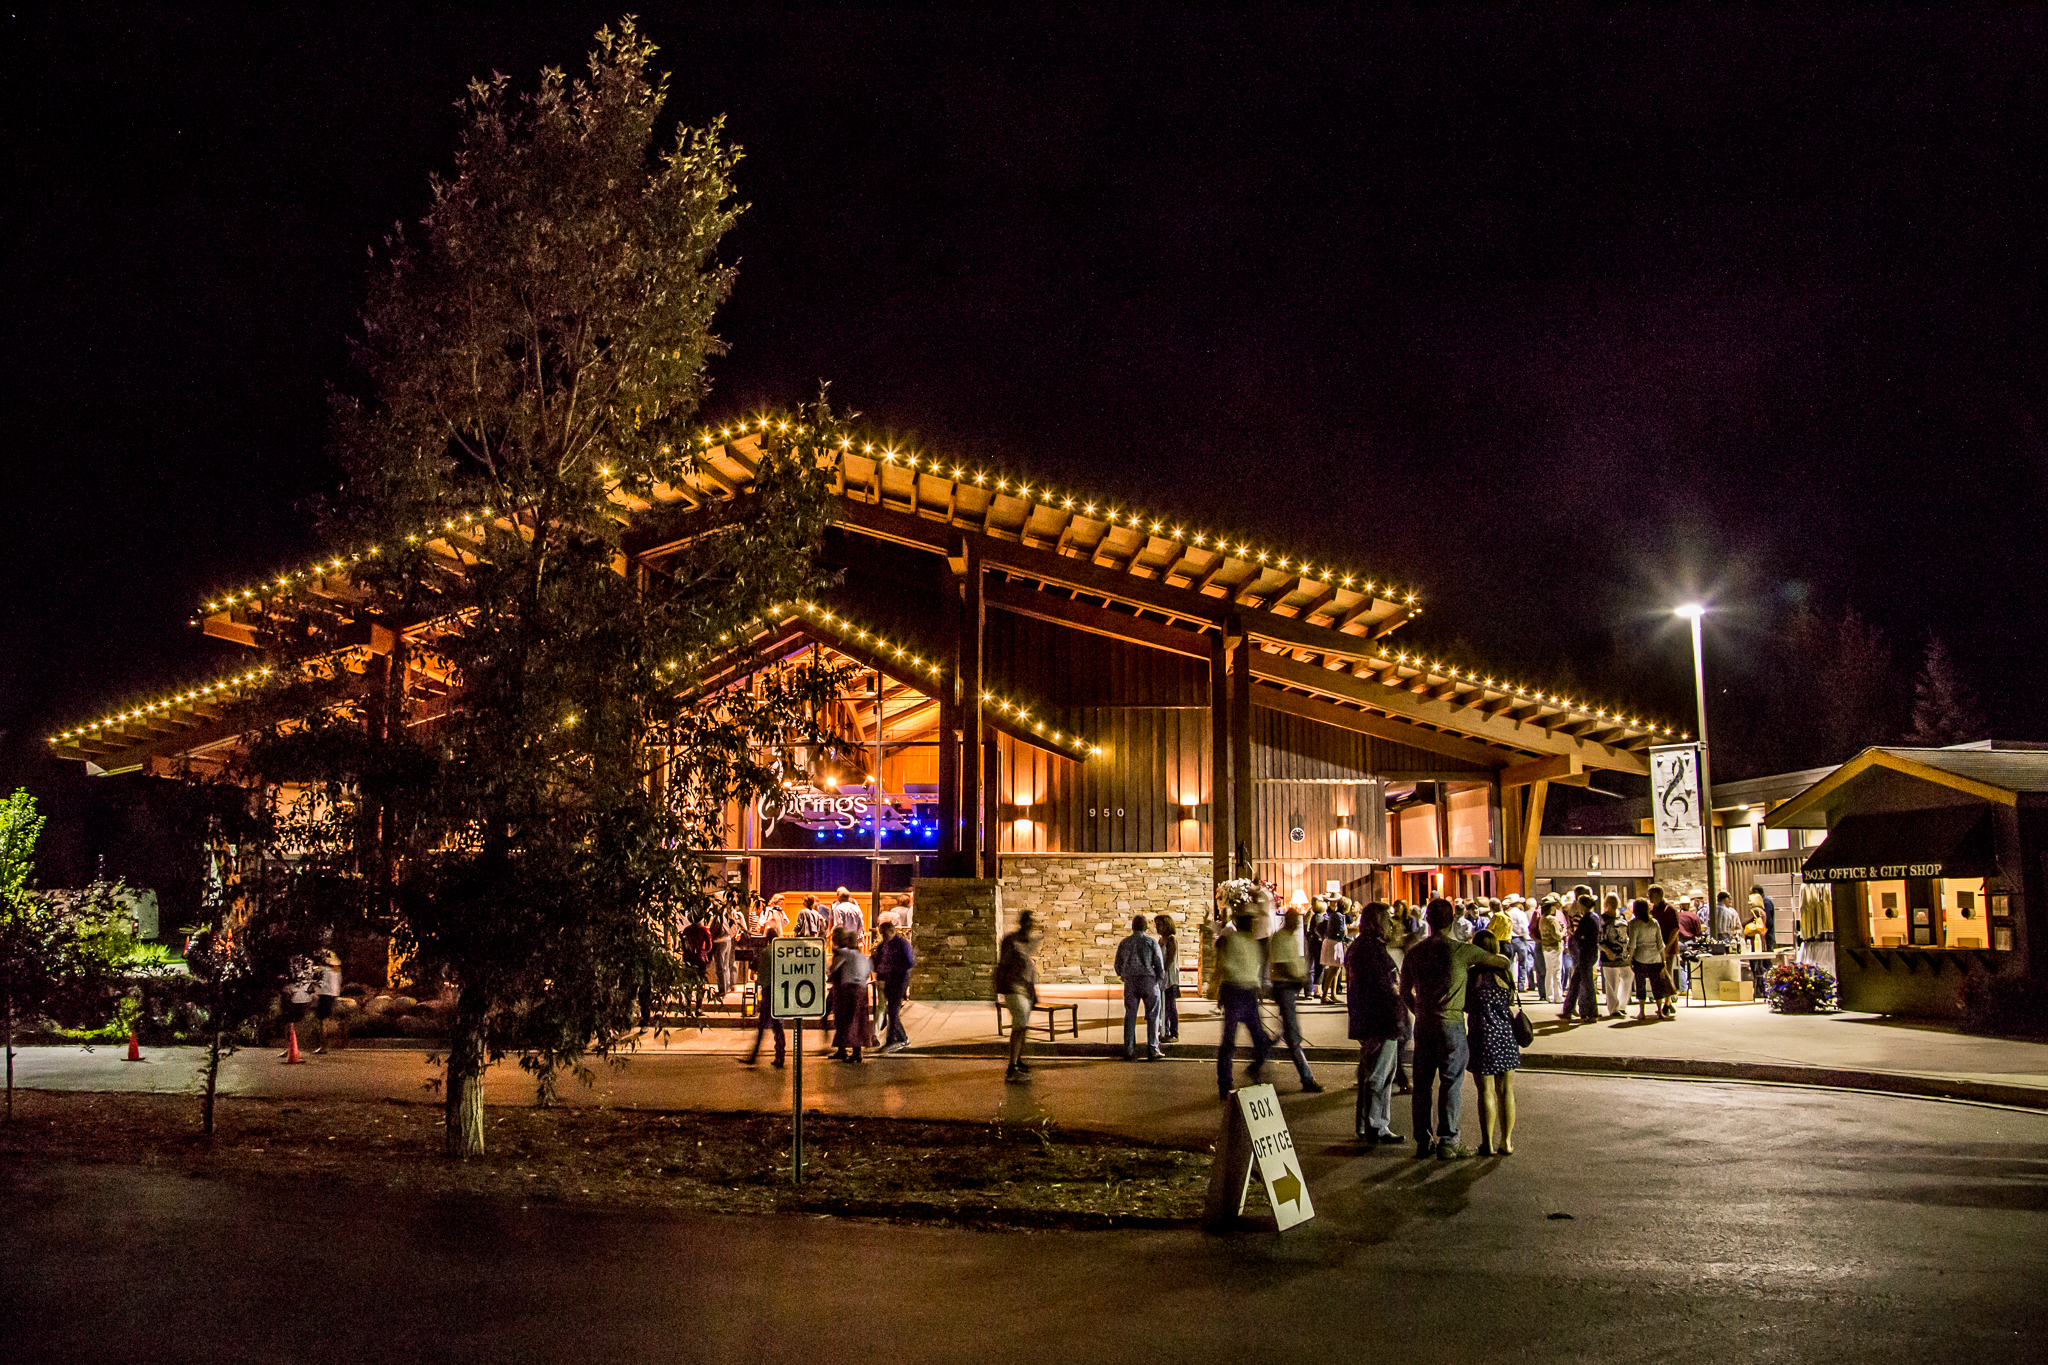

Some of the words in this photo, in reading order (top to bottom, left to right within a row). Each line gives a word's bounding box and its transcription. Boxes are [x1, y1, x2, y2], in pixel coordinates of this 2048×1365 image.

[1089, 808, 1124, 817] 950
[1804, 869, 1826, 880] BOX
[1829, 867, 1867, 879] OFFICE
[1869, 866, 1878, 877] &
[1880, 865, 1908, 877] GIFT
[1909, 864, 1942, 876] SHOP
[777, 947, 821, 958] SPEED
[782, 963, 816, 975] LIMIT
[781, 980, 816, 1008] 10
[1249, 1097, 1274, 1121] BOX
[1254, 1130, 1293, 1159] OFFICE
